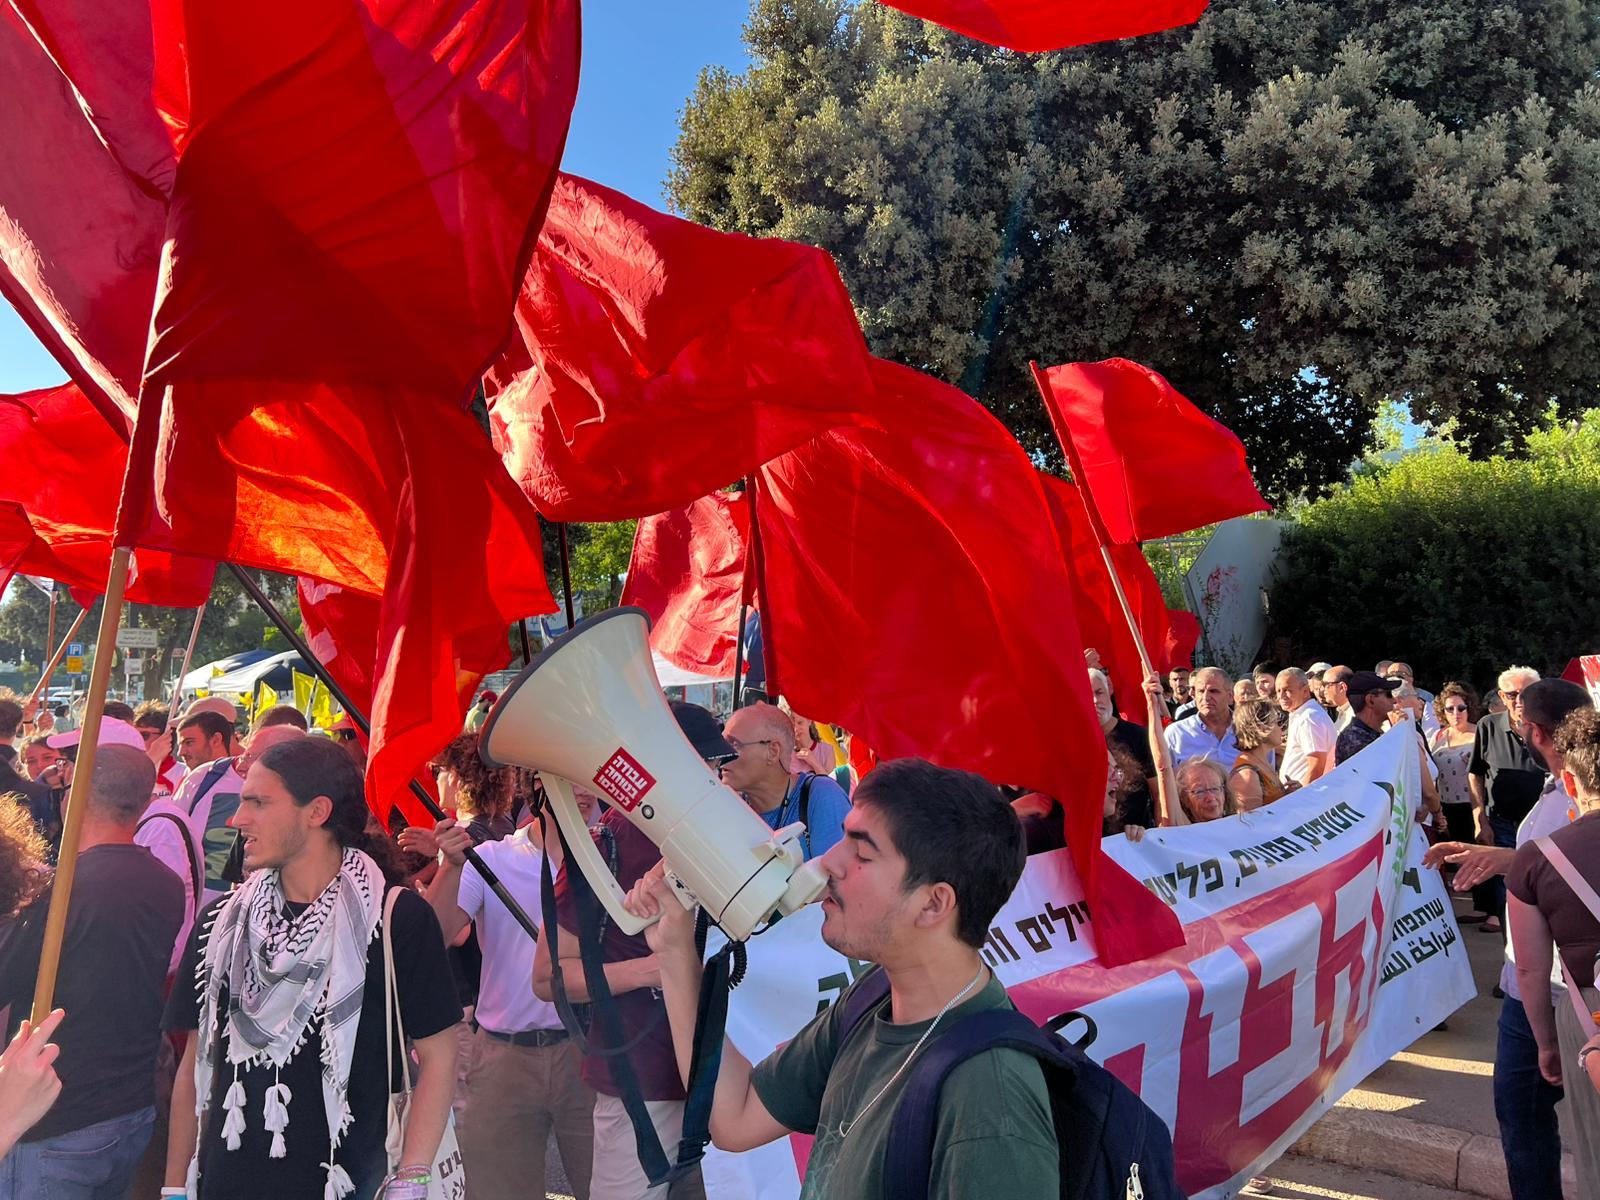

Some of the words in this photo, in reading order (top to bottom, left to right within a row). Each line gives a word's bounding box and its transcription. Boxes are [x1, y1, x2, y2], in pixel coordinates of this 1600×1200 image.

[597, 774, 631, 807] לכולם!
[604, 765, 638, 800] בטוחה
[612, 755, 648, 790] עבודה
[1229, 836, 1306, 888] מפונים,
[982, 926, 1021, 967] וה
[1015, 900, 1092, 953] יילים
[1410, 918, 1456, 964] شراكة
[1379, 950, 1412, 987] الس
[1047, 856, 1378, 1144] הבית
